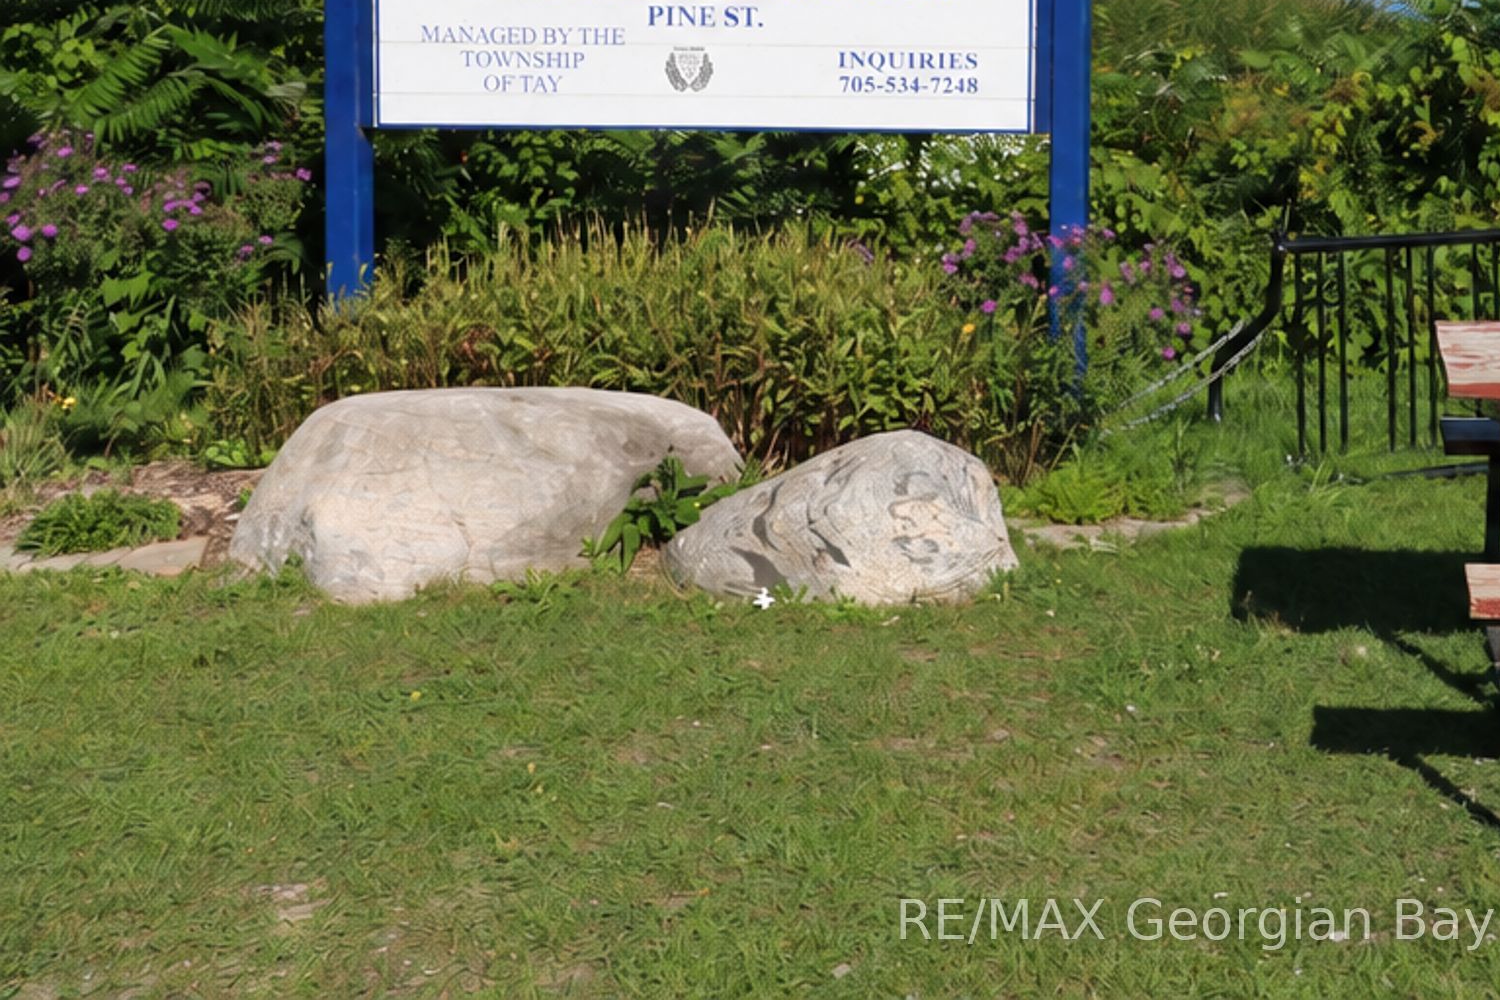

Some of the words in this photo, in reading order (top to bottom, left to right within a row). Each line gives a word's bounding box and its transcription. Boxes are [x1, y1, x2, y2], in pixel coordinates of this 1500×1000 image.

[648, 5, 716, 27] PINE
[723, 6, 764, 28] ST.
[421, 25, 537, 45] MANAGED
[543, 26, 572, 45] BY
[578, 27, 625, 46] THE
[460, 50, 585, 69] TOWNSHIP
[838, 51, 978, 73] INQUIRIES
[483, 74, 515, 93] OF
[520, 75, 563, 93] TAY
[839, 75, 978, 94] 705-534-7248
